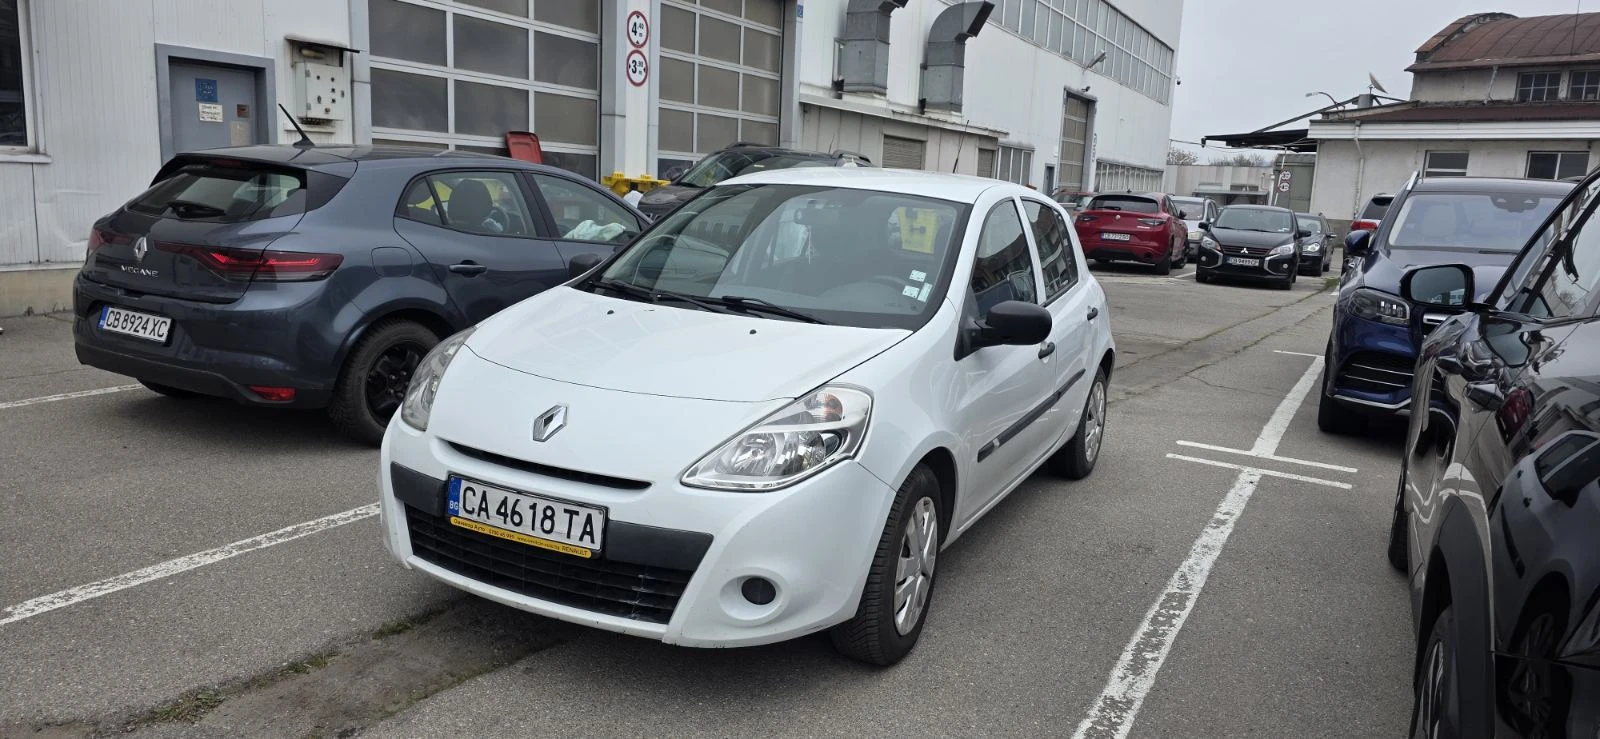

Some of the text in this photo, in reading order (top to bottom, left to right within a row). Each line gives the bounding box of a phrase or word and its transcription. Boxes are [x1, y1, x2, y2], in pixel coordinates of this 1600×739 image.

[121, 265, 159, 277] MEGANE
[106, 310, 168, 338] CB 8924 XC
[450, 500, 459, 511] BG
[462, 486, 490, 520] CA
[496, 496, 555, 535] 4618
[563, 508, 595, 544] TA
[562, 545, 588, 556] RENAULT
